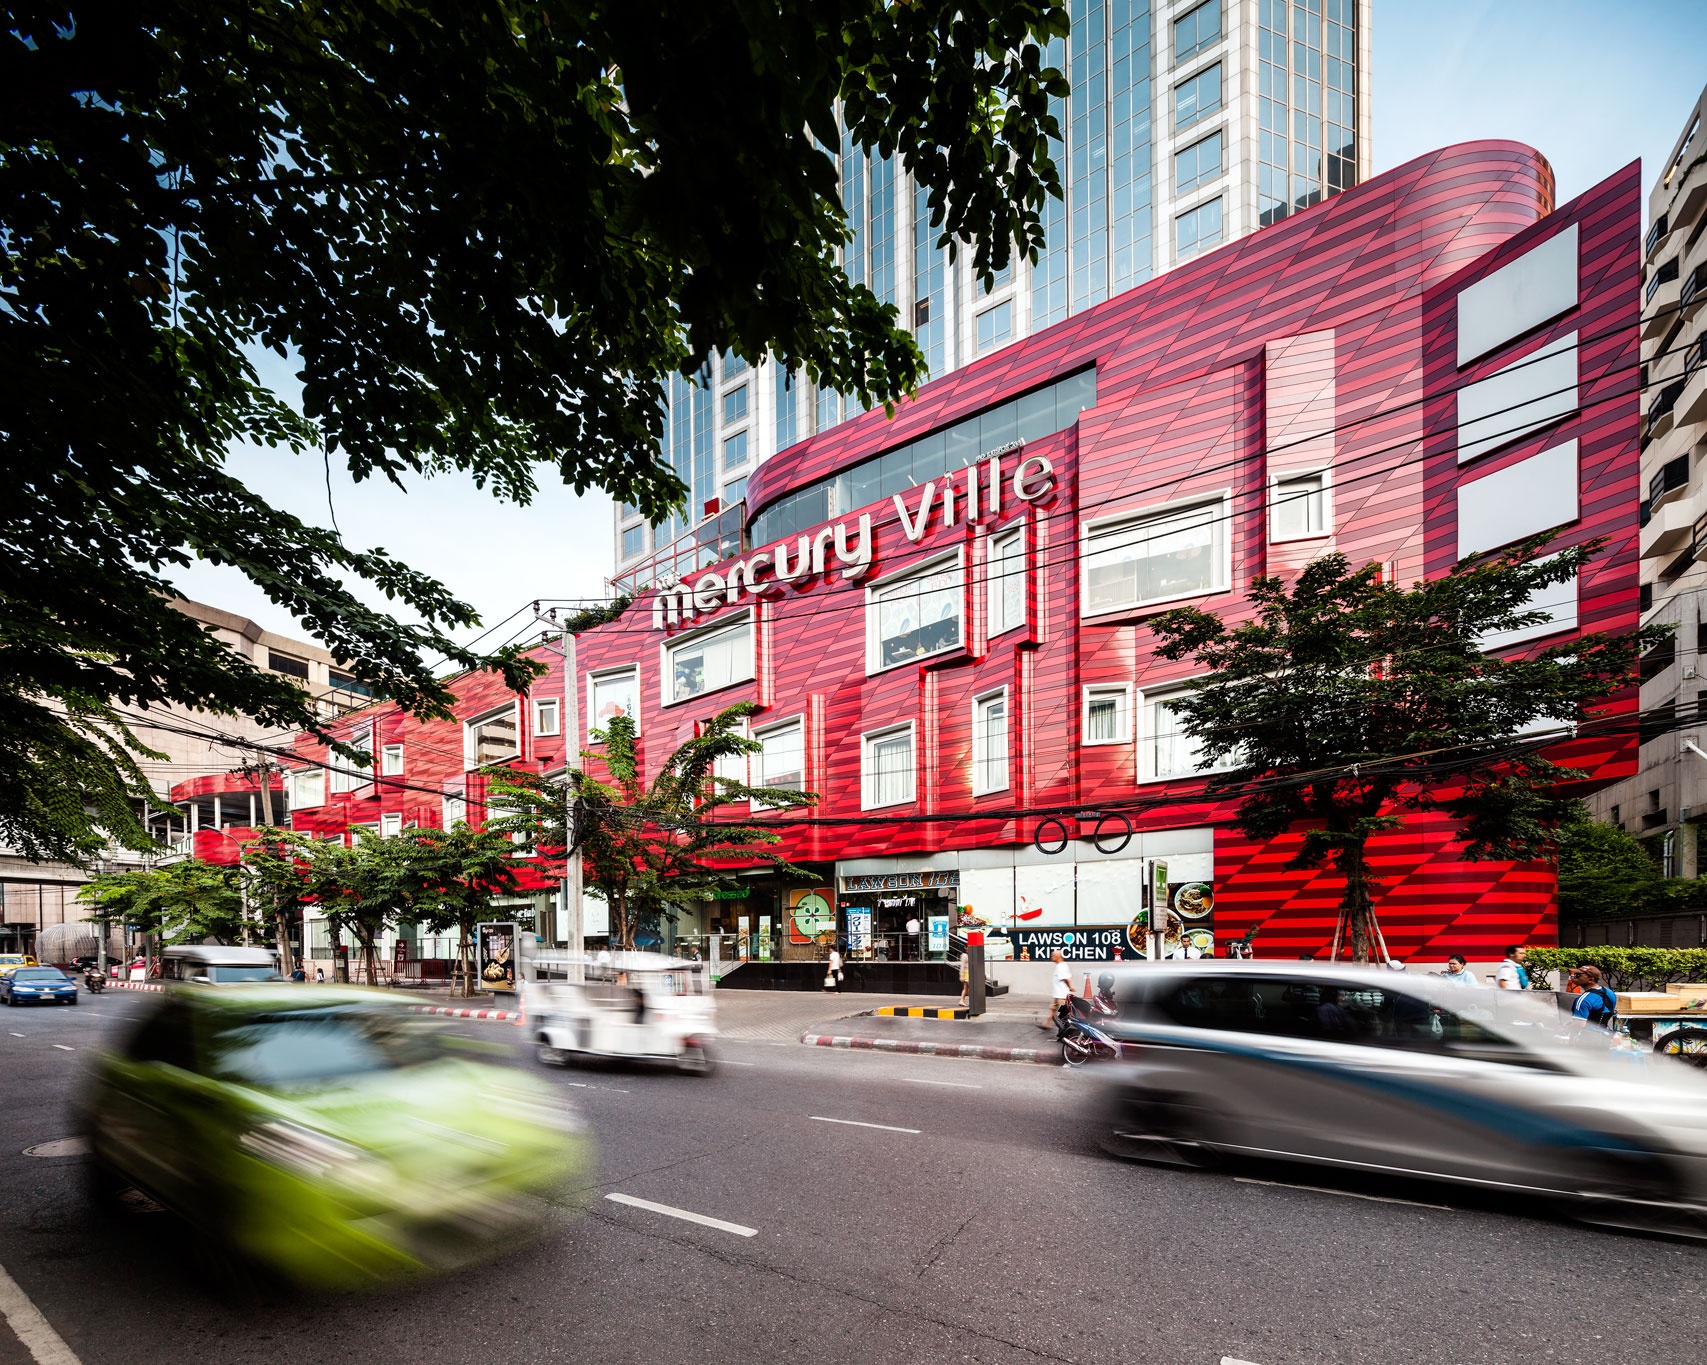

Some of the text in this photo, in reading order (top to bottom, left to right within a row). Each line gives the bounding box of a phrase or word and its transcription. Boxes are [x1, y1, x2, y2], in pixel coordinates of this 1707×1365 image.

[652, 453, 1054, 630] mercury Ville
[847, 873, 923, 891] LAWSON
[1019, 932, 1121, 945] LAWSON 108
